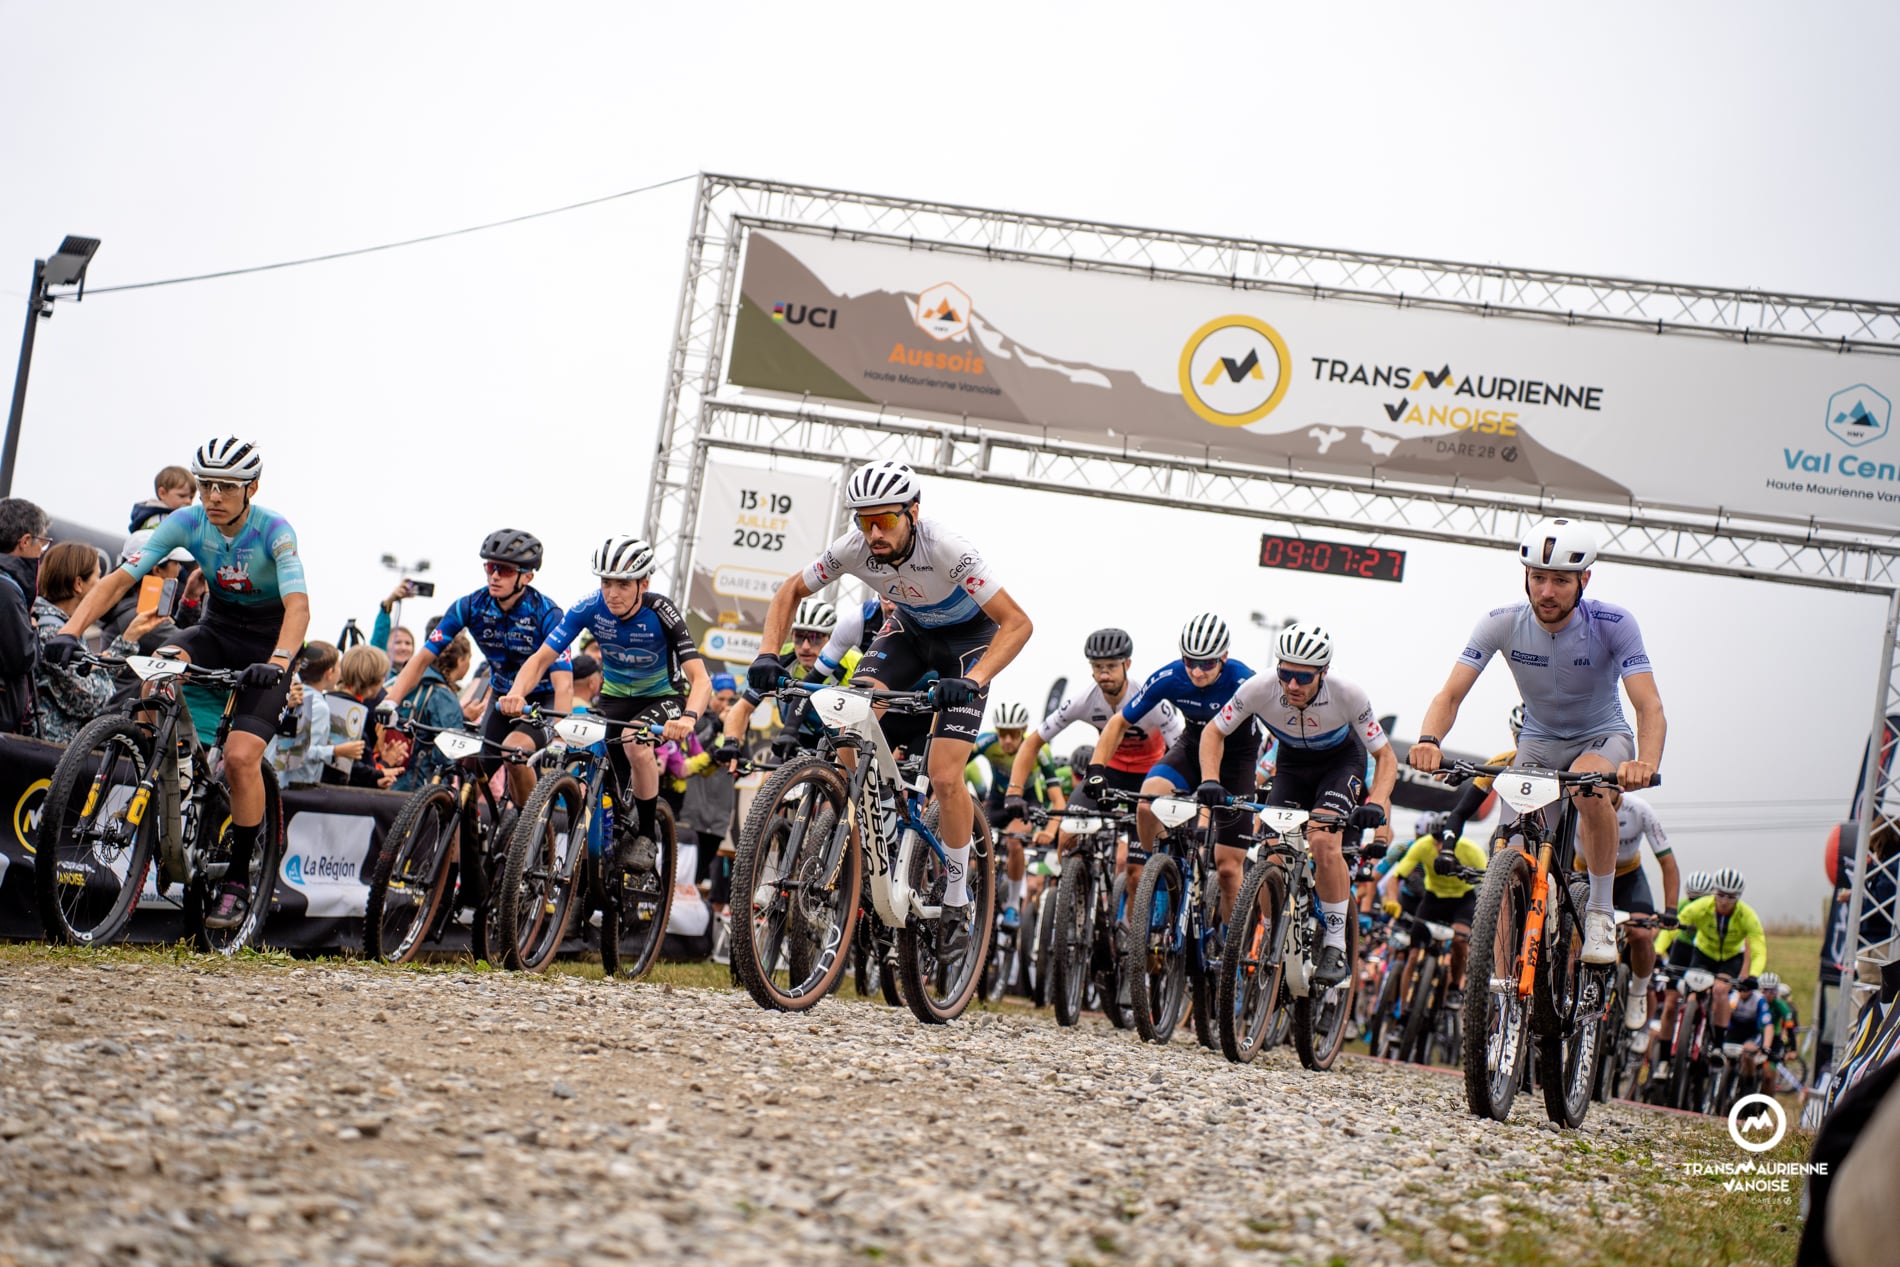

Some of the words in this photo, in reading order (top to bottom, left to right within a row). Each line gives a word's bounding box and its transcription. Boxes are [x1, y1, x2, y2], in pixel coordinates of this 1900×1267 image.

[786, 303, 838, 330] UCI
[888, 343, 985, 375] Aussois
[864, 369, 896, 383] Haute
[898, 374, 958, 391] Maurienne
[959, 380, 1003, 396] Vanoise
[1311, 357, 1604, 411] TRANSMAURIENNE
[1383, 397, 1520, 437] VANOISE
[1783, 447, 1831, 475] Val
[1838, 454, 1900, 483] Cen
[1766, 478, 1804, 493] Haute
[1806, 483, 1875, 501] Maurienne
[740, 489, 758, 510] 13
[770, 493, 792, 515] 19
[736, 513, 790, 532] JUILLET
[733, 528, 786, 551] 2025
[1263, 537, 1402, 578] 09:07:27
[662, 601, 682, 624] TRUE
[146, 659, 167, 671] 10
[1131, 668, 1174, 709] BULLS
[833, 697, 846, 712] 3
[572, 724, 588, 736] 11
[451, 738, 466, 751] 15
[1520, 781, 1533, 796] 8
[866, 765, 889, 878] ORBEA
[1170, 804, 1177, 815] 1
[1277, 811, 1294, 822] 12
[303, 856, 317, 876] La
[318, 855, 356, 881] Région
